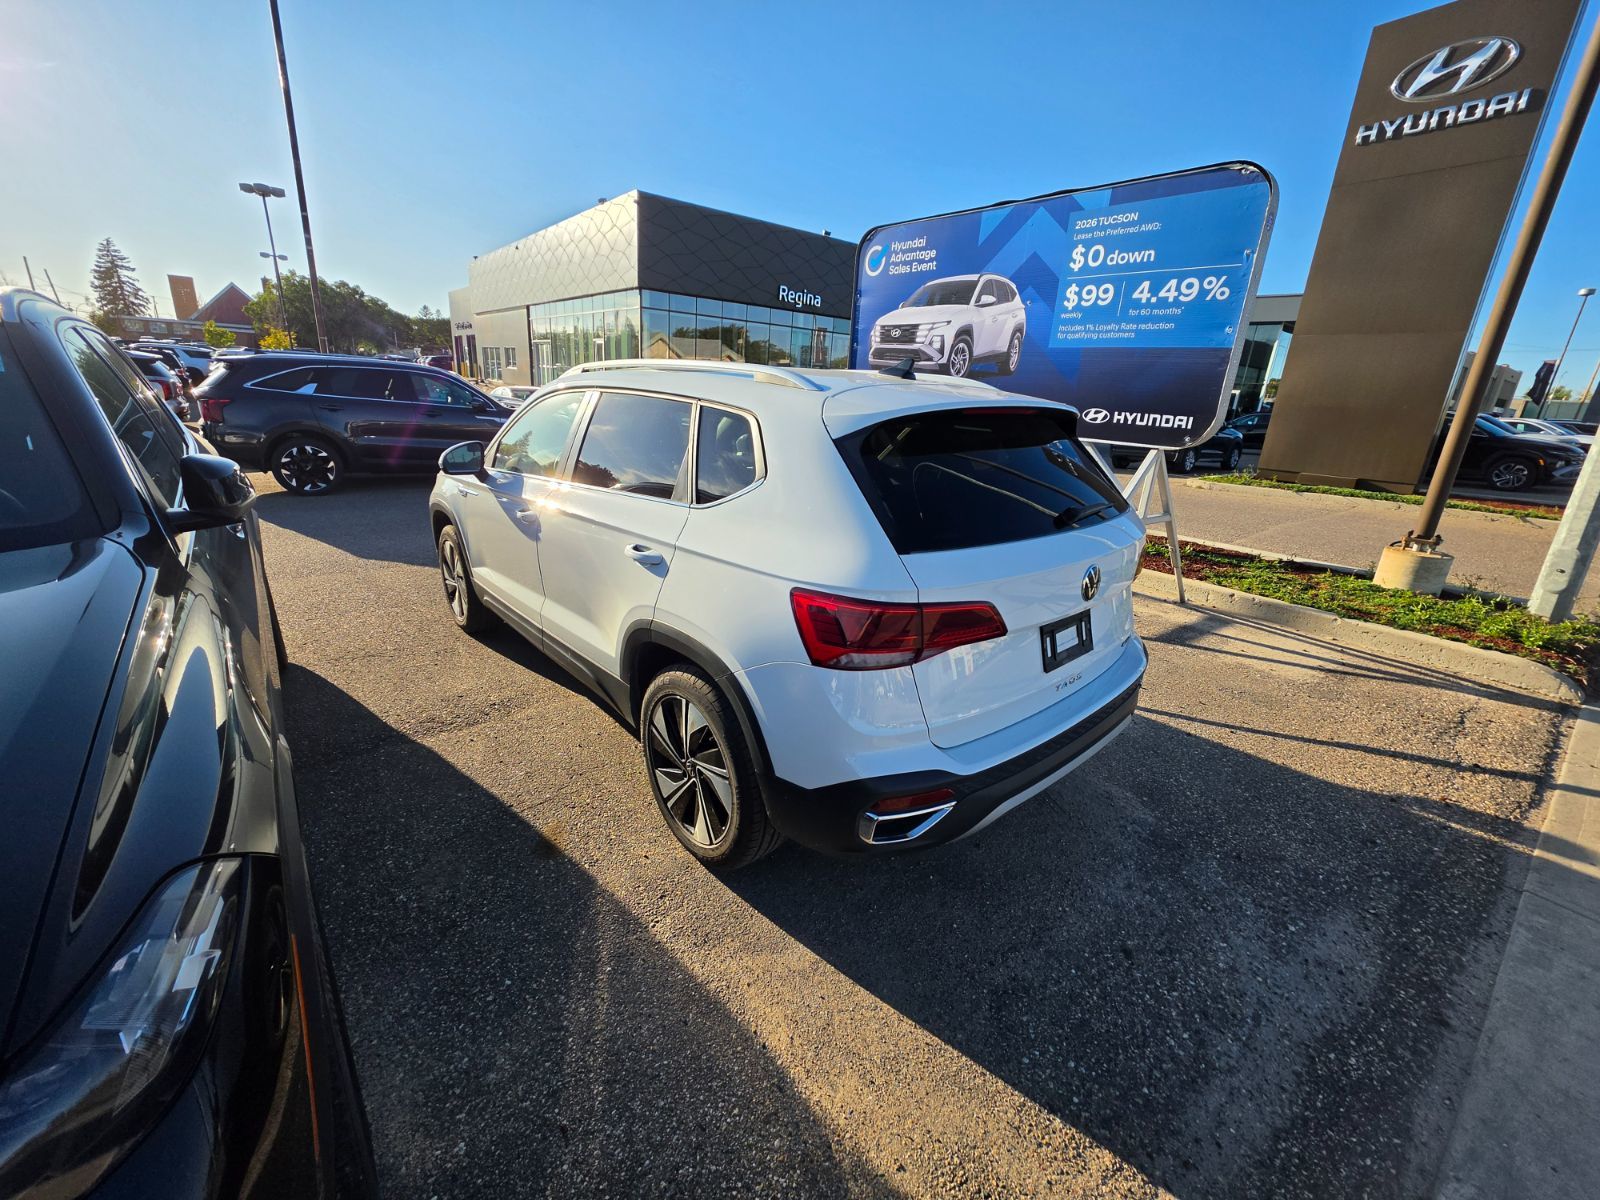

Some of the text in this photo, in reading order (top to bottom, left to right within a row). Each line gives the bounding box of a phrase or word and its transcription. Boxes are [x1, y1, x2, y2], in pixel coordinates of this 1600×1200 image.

[1355, 88, 1533, 146] HYUNDAI
[1075, 212, 1139, 230] 2026 TUCSON
[1073, 222, 1162, 241] Lease the Preferred AWD:
[891, 236, 927, 252] Hyundai
[890, 249, 937, 263] Advantage
[1069, 244, 1155, 272] $0 down
[888, 261, 937, 275] Sales Event
[779, 285, 822, 308] Regina
[1063, 283, 1115, 310] $99
[1132, 275, 1231, 303] 4.49%
[1060, 311, 1082, 319] weekly
[1140, 308, 1151, 316] 60
[1058, 324, 1085, 332] Includes
[1095, 323, 1119, 332] Loyalty
[1120, 322, 1137, 330] Rate
[1138, 322, 1175, 330] reduction
[1066, 332, 1098, 340] qualifying
[1113, 411, 1194, 429] HYUNDAI
